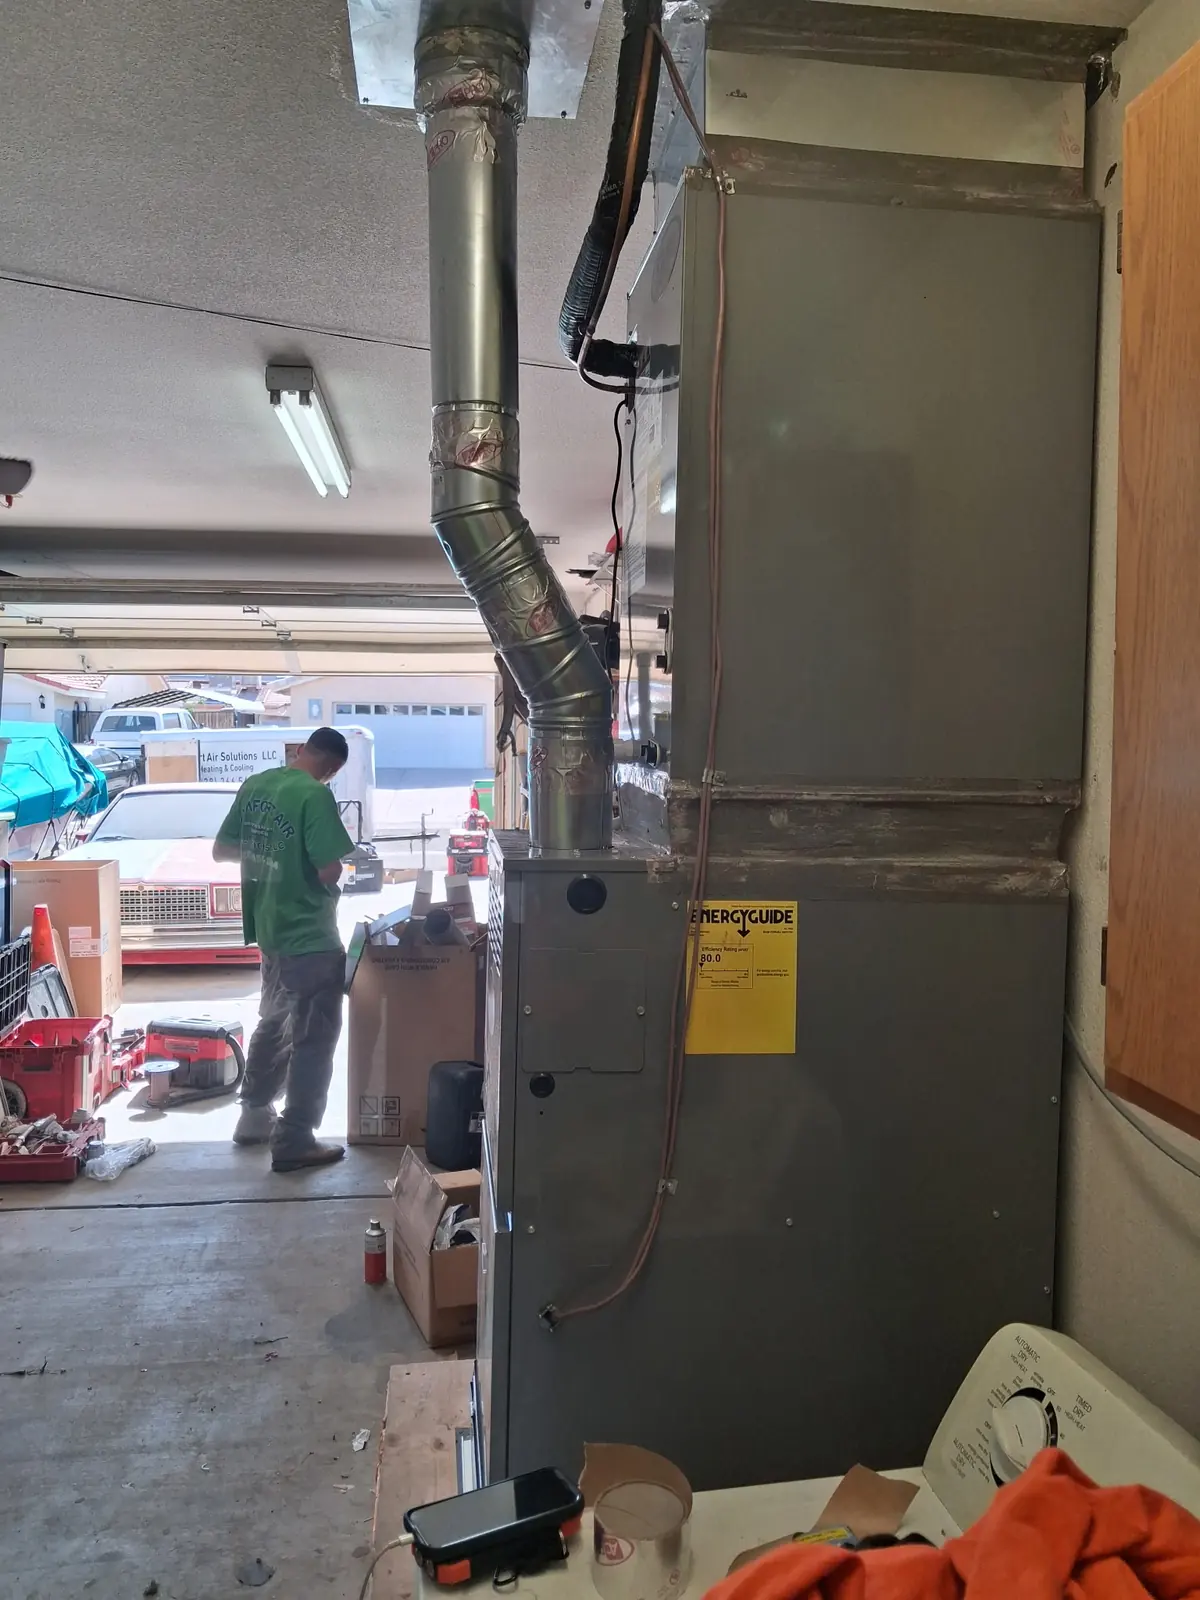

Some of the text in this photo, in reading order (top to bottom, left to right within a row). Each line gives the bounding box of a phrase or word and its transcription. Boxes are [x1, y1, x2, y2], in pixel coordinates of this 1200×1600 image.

[207, 753, 219, 762] Air
[220, 751, 258, 761] Solutions
[262, 750, 277, 760] LLC
[224, 764, 229, 773] &
[230, 763, 254, 773] Cooling
[274, 813, 295, 839] AIR
[700, 953, 721, 963] 80.0
[1015, 1336, 1041, 1363] AUTOMATIC
[1017, 1350, 1028, 1362] DRY
[1046, 1386, 1056, 1396] OFF
[1075, 1394, 1092, 1413] TIMED
[1072, 1405, 1086, 1419] DRY
[952, 1438, 977, 1469] AUTOMATIC
